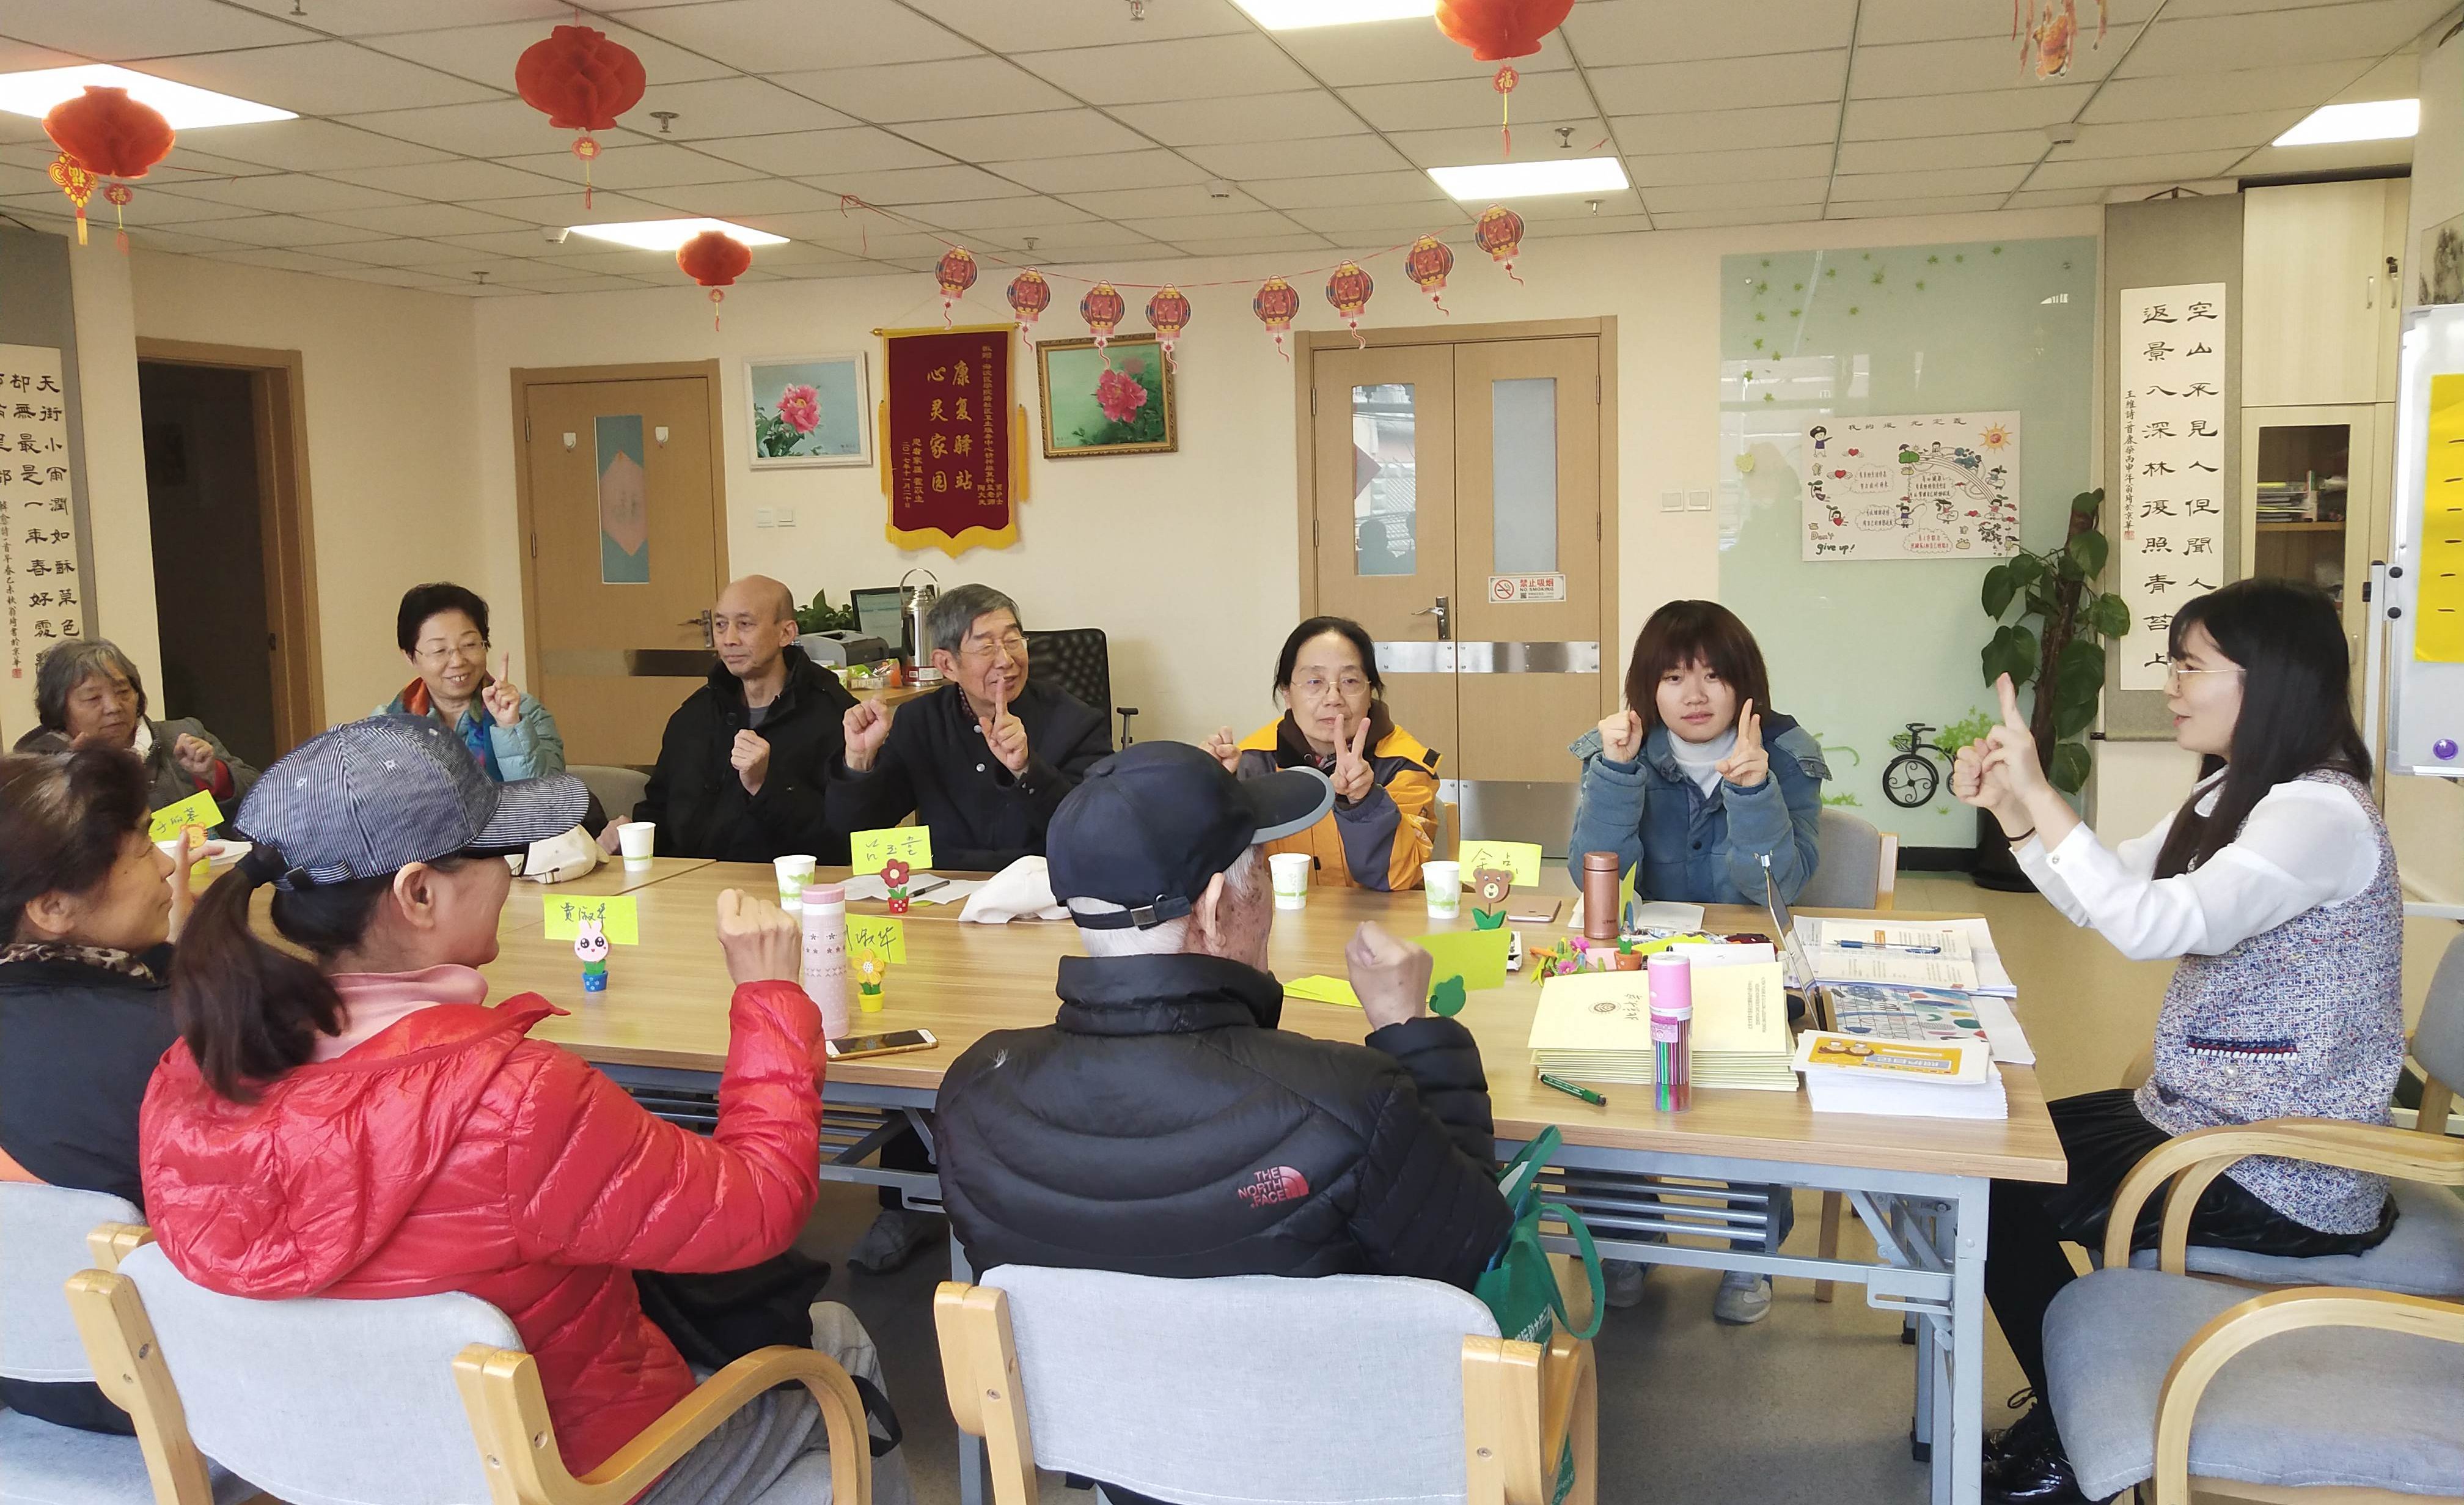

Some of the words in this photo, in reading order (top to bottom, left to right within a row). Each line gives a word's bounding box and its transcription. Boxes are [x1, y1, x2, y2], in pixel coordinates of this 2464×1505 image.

[1498, 70, 1513, 89] 福
[927, 367, 948, 492] 心灵家园
[952, 360, 973, 490] 康复驿站
[1816, 543, 1836, 555] give
[1839, 544, 1855, 554] up!
[1519, 578, 1554, 587] 禁止吸烟
[1254, 1166, 1280, 1182] THE
[1238, 1178, 1283, 1199] NORTH
[1253, 1190, 1286, 1207] FACE
